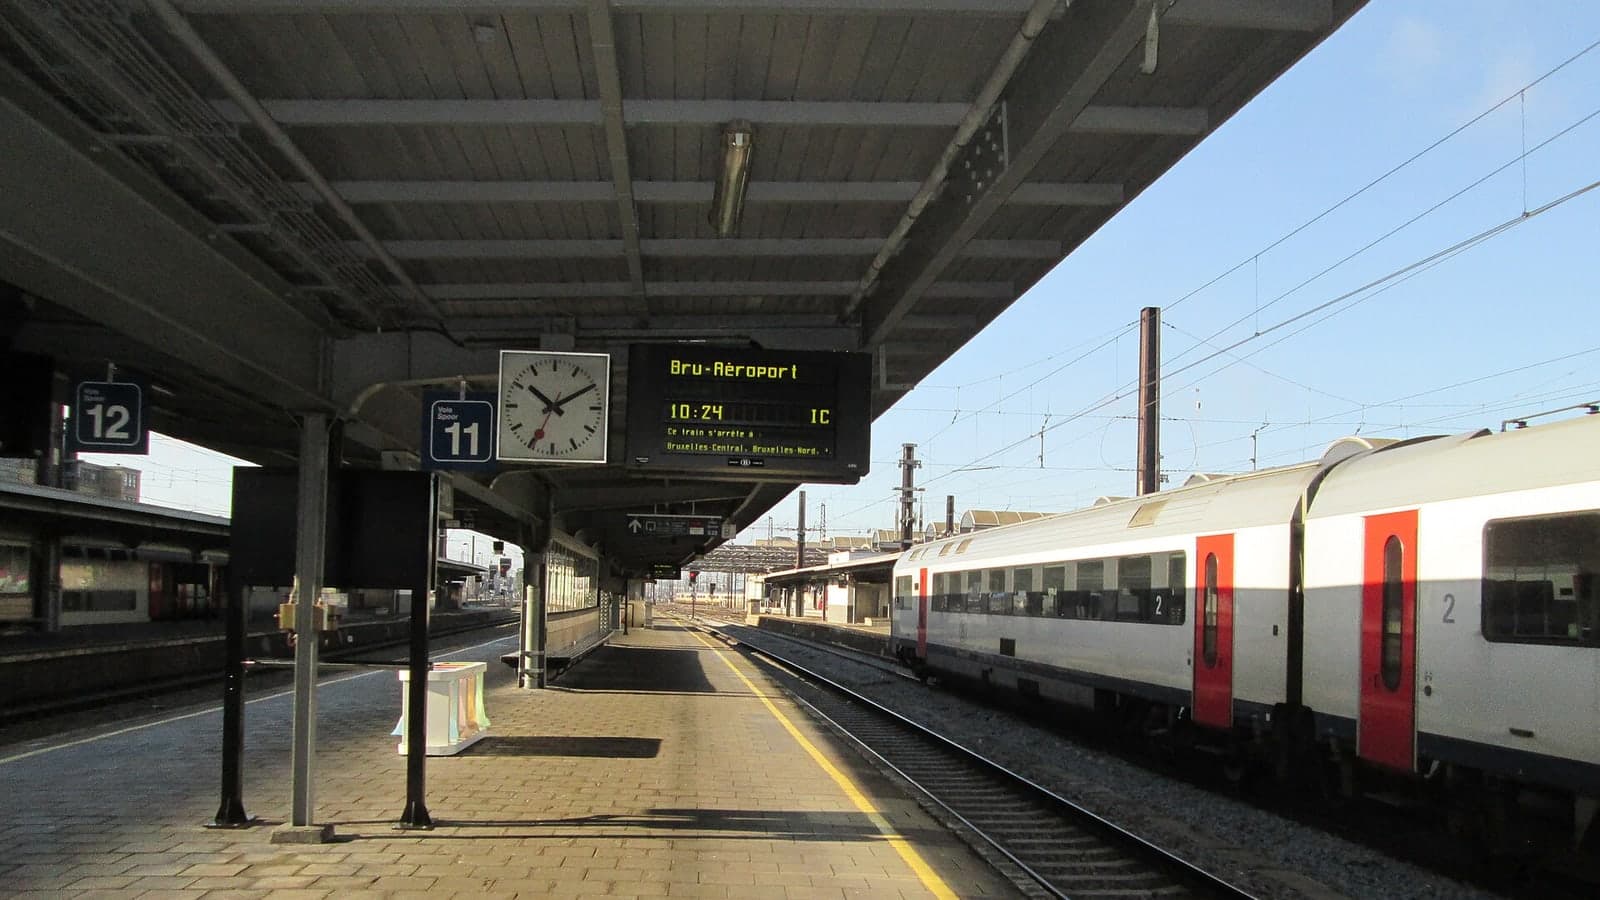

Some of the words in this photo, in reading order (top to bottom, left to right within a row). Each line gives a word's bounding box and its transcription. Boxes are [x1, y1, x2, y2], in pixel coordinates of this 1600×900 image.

[670, 360, 798, 379] Bru-Aéroport
[86, 404, 130, 439] 12
[437, 413, 459, 421] Spoor
[671, 404, 723, 420] 10:24
[811, 409, 830, 424] IC
[445, 422, 479, 456] 11
[667, 427, 678, 436] Ce
[682, 428, 704, 437] train
[1155, 595, 1162, 616] 2
[1442, 593, 1456, 624] 2
